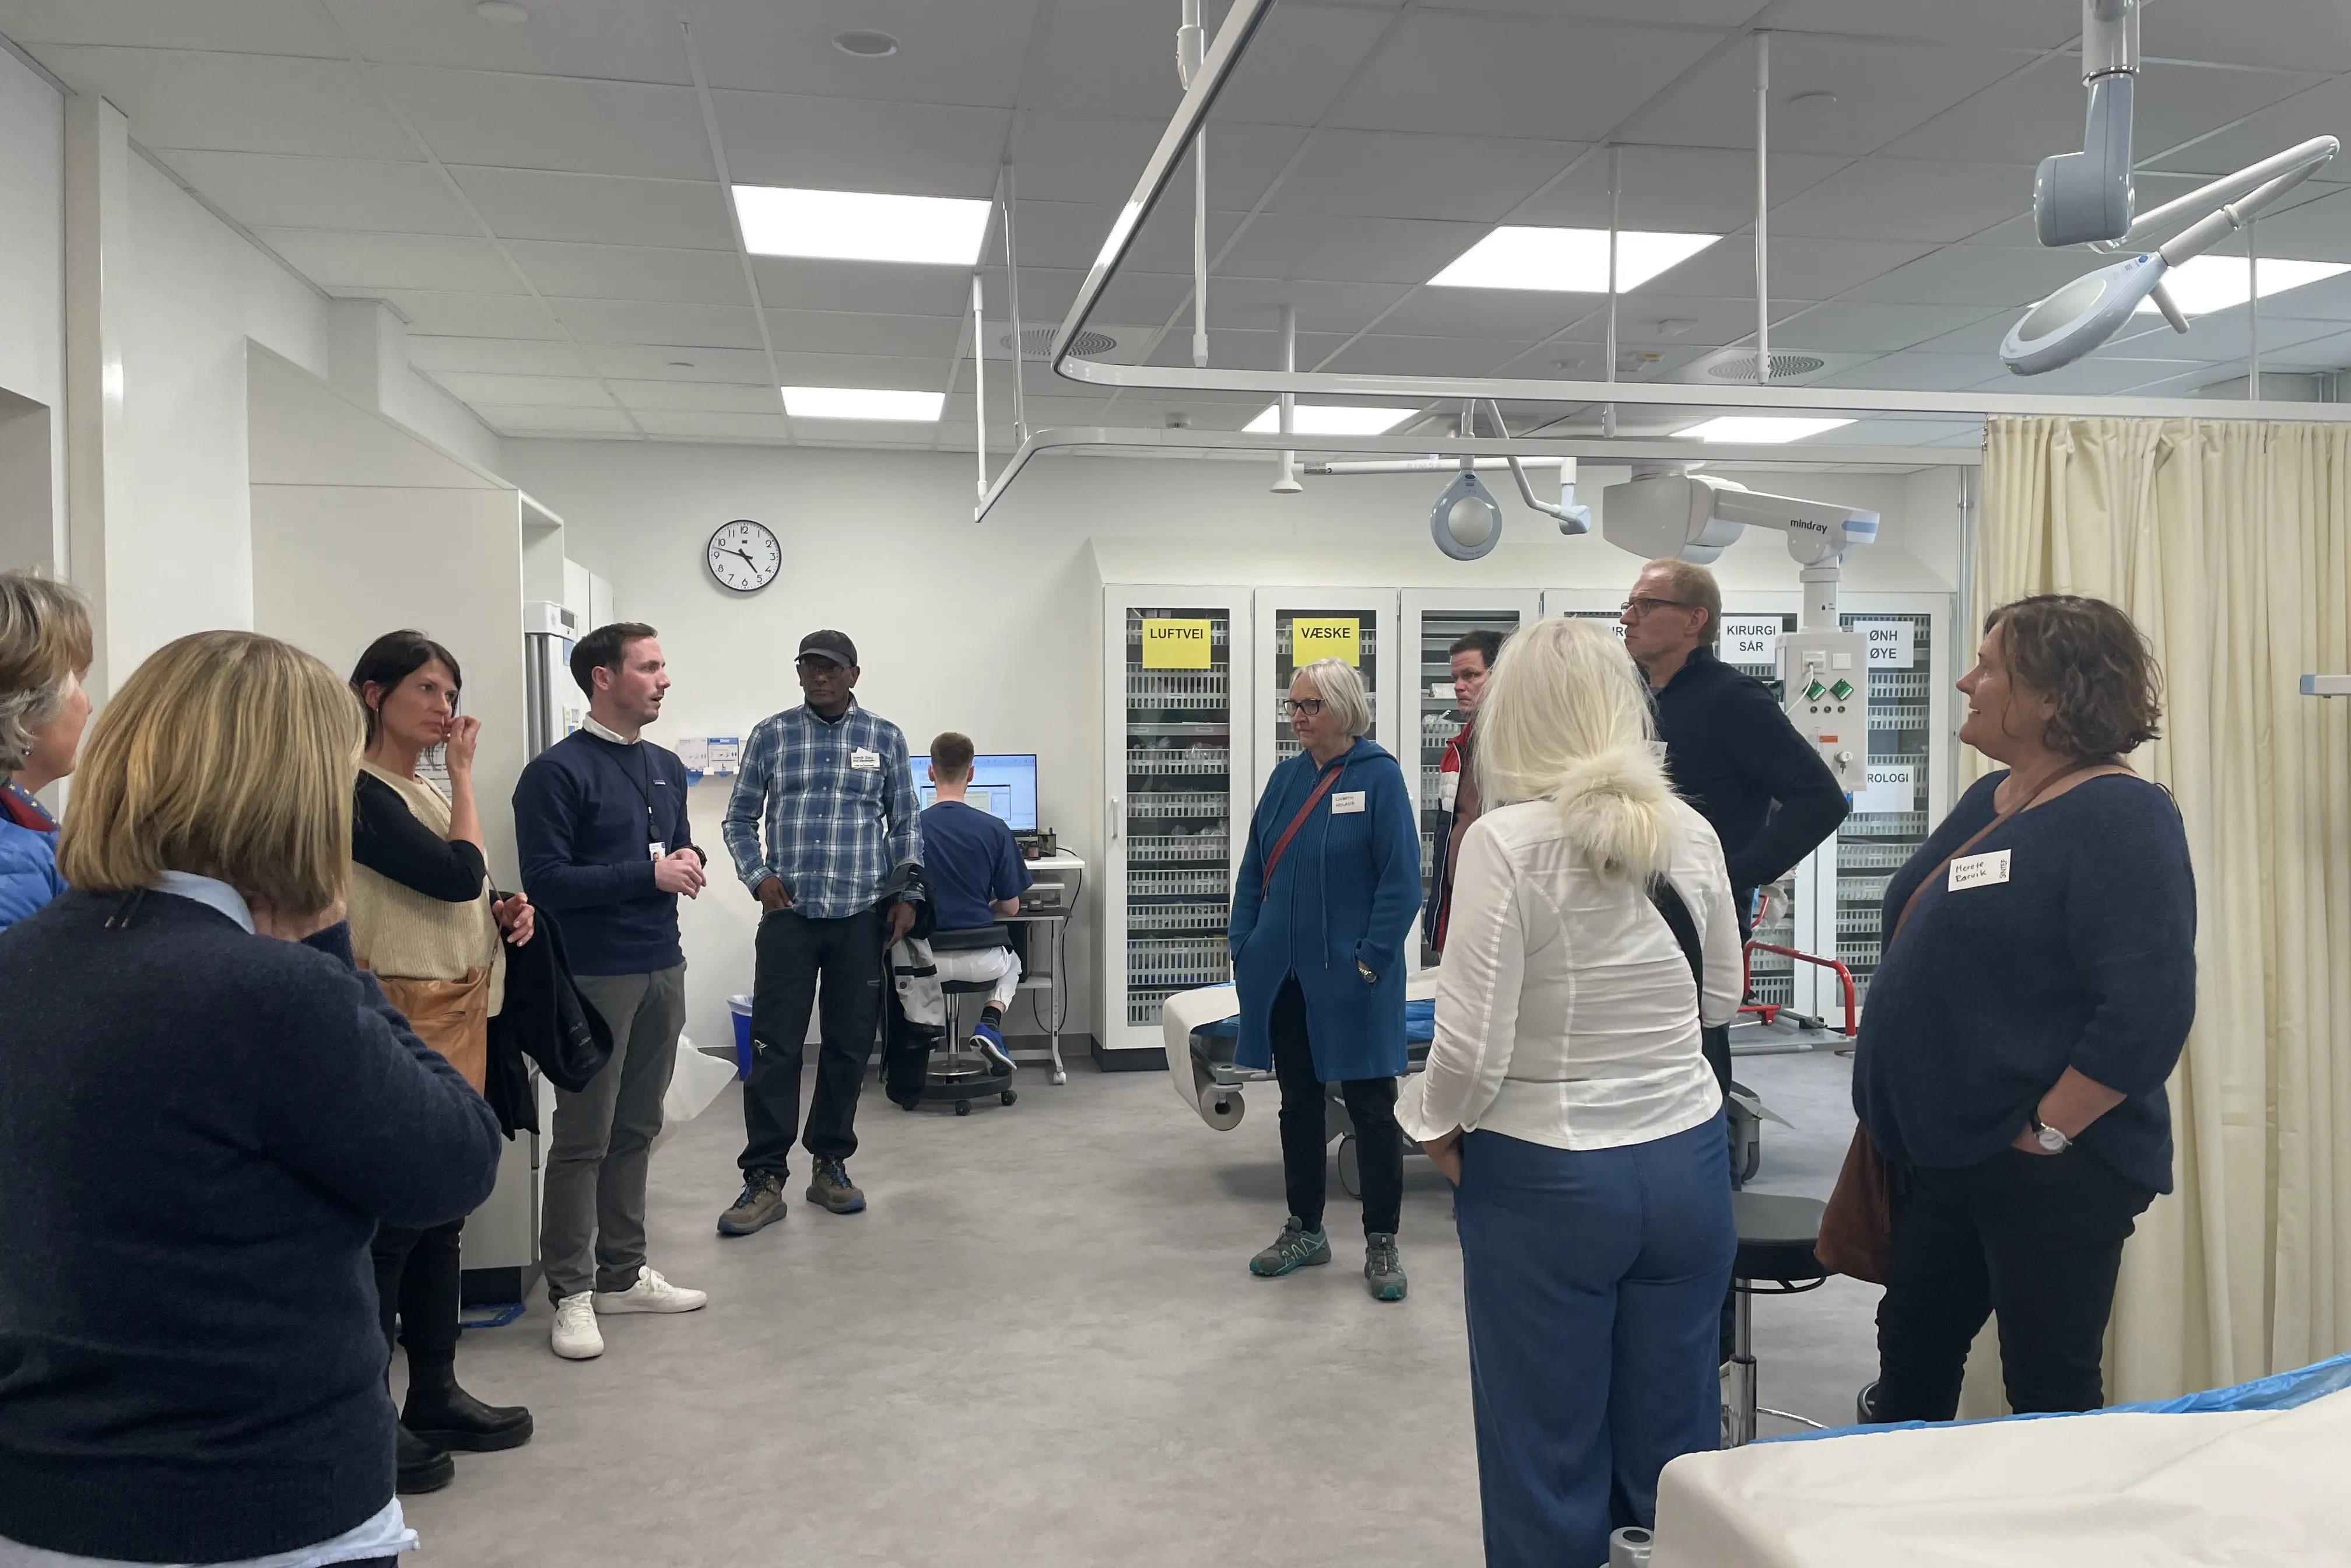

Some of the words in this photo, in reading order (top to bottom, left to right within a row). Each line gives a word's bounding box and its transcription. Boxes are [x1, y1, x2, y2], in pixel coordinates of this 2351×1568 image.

[740, 526, 749, 534] 12
[1790, 519, 1828, 535] mindray
[728, 529, 735, 538] 11
[766, 540, 772, 548] 2
[714, 551, 720, 559] 9
[770, 553, 776, 561] 3
[718, 564, 724, 573] 8
[728, 574, 735, 582] 7
[742, 578, 748, 587] 6
[756, 574, 763, 583] 5
[1150, 628, 1203, 639] LUFTVEI
[1301, 627, 1350, 639] VÆSKE
[1727, 625, 1775, 635] KIRURGI
[1869, 630, 1897, 641] ØNH
[1739, 640, 1764, 651] SÅR
[1870, 648, 1897, 659] ØYE
[1956, 862, 1984, 873] Merete
